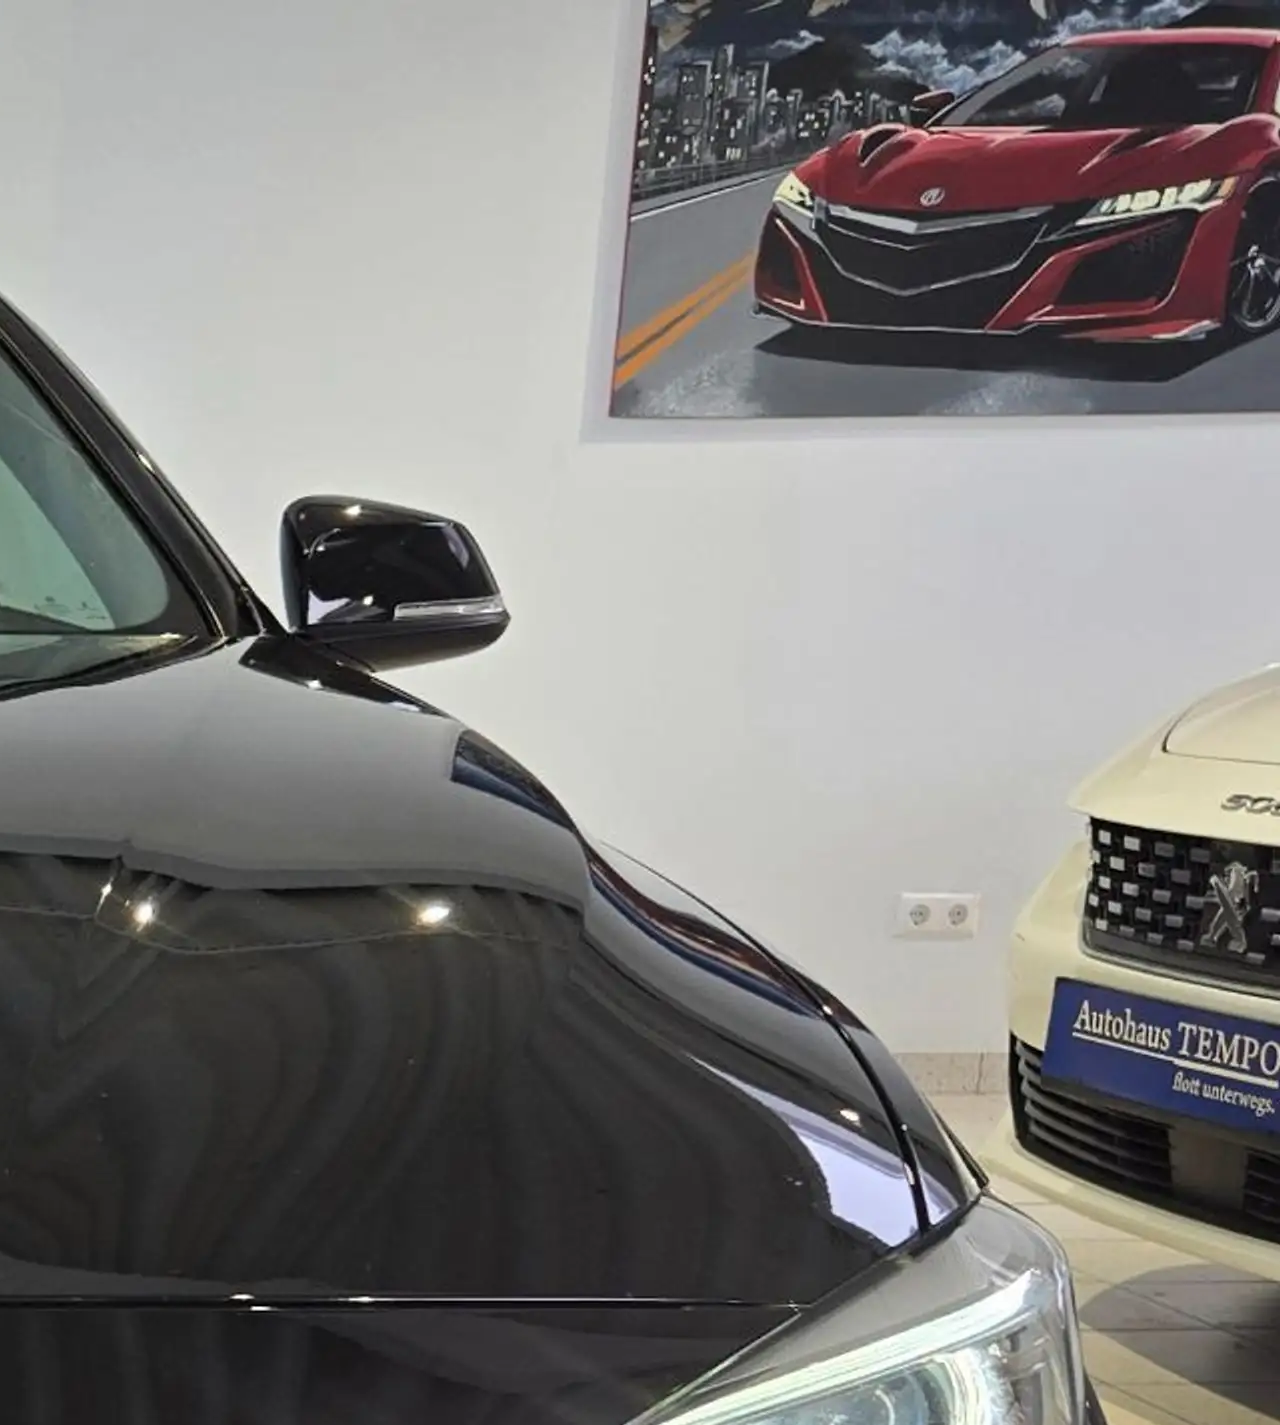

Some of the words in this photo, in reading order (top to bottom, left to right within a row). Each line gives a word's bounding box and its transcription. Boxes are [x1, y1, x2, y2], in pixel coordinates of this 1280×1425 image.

[1073, 999, 1172, 1051] Autohaus
[1177, 1021, 1280, 1076] TEMPO
[1172, 1071, 1201, 1097] flott
[1202, 1084, 1276, 1118] unterwegs.
